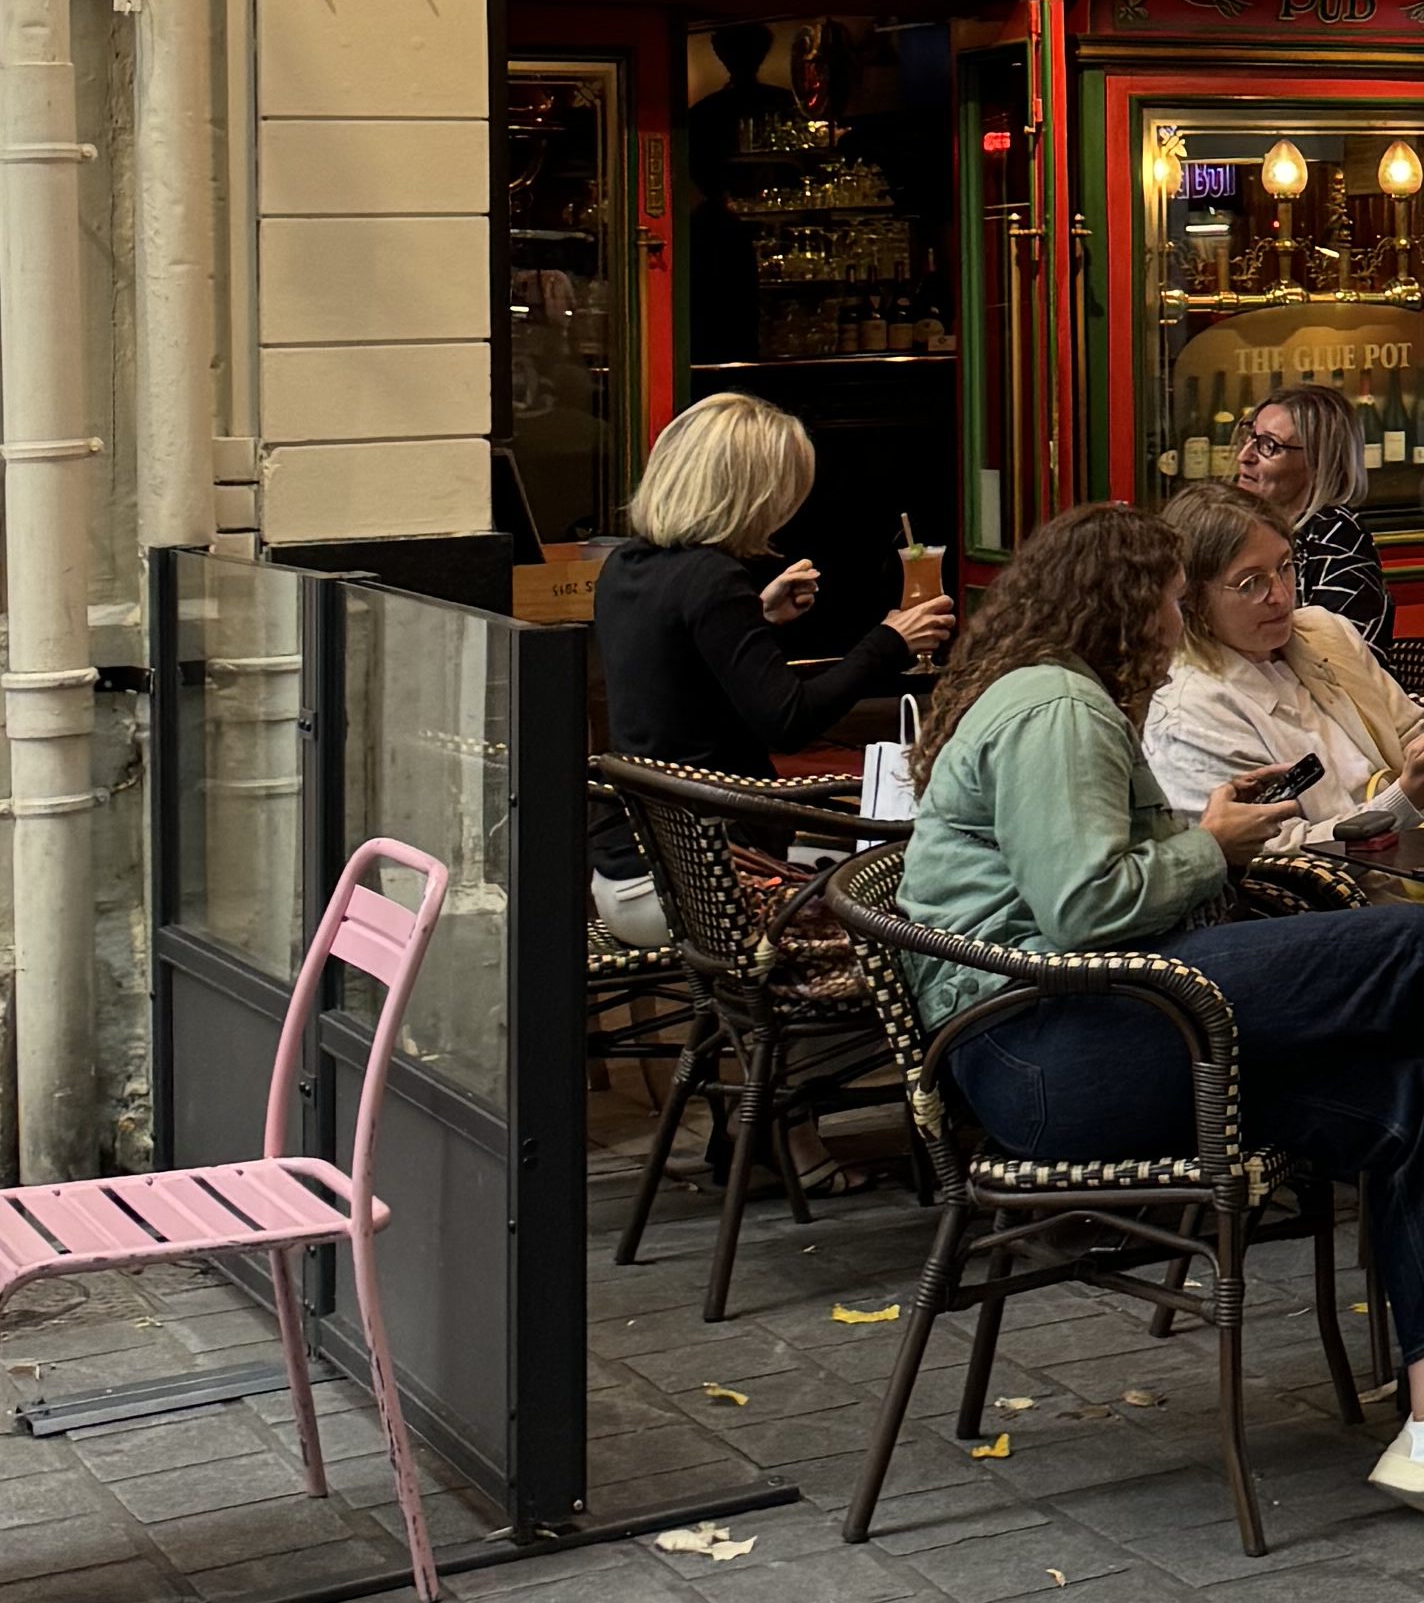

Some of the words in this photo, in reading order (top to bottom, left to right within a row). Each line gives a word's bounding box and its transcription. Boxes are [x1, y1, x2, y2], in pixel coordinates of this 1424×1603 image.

[1234, 347, 1284, 375] THE
[1293, 344, 1356, 372] GLUE
[1363, 342, 1412, 369] POT
